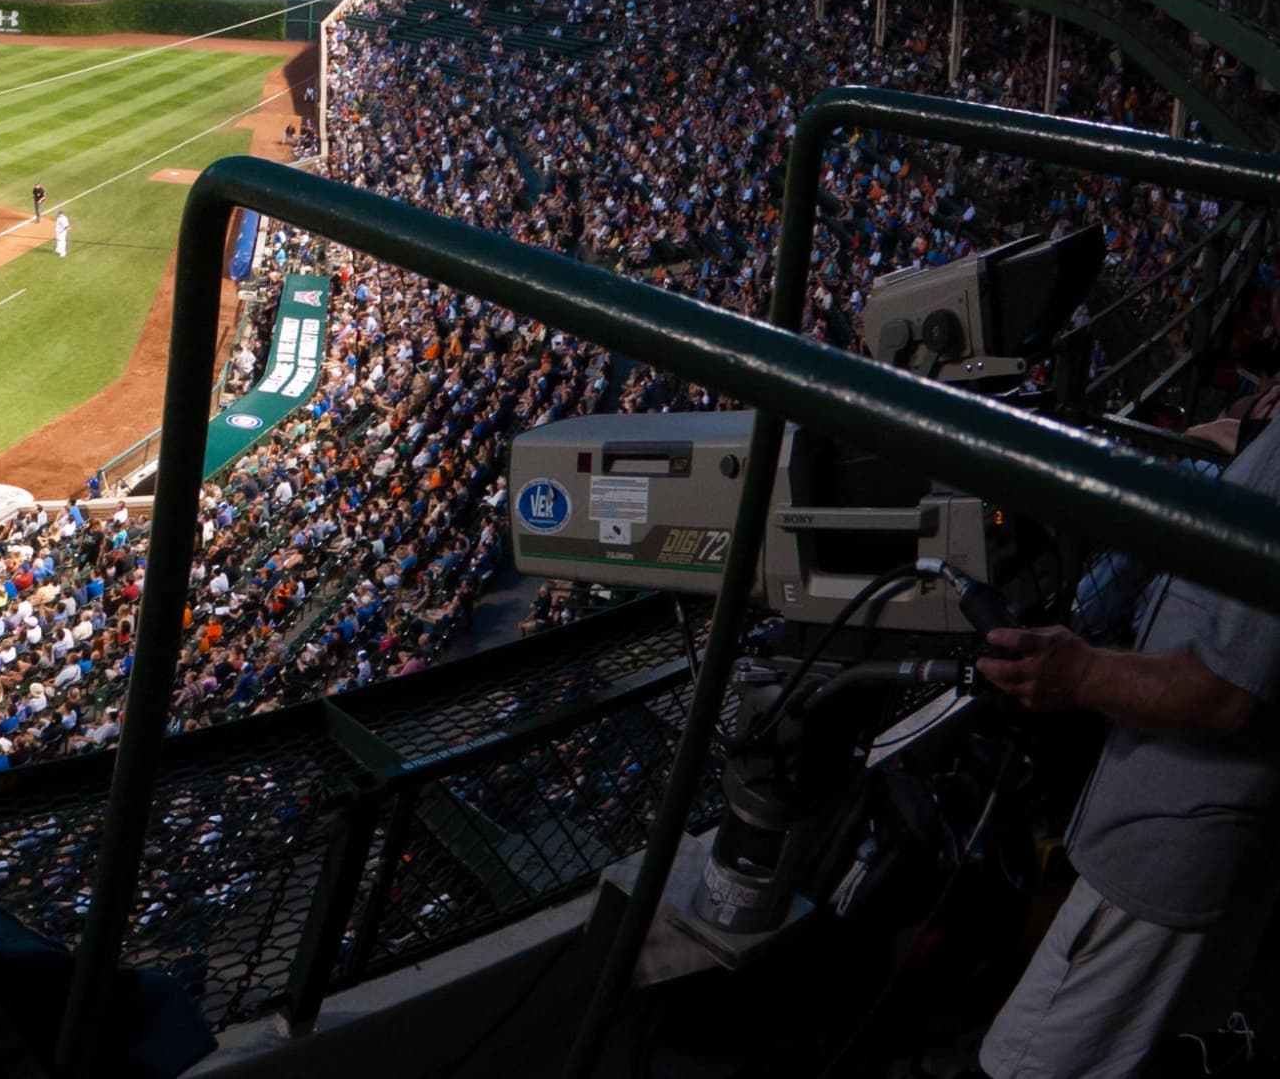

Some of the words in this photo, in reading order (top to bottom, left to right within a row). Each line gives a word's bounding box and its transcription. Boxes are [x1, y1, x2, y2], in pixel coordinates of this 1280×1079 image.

[784, 515, 814, 524] SONY
[661, 528, 704, 553] DIGI
[698, 530, 731, 561] 72
[783, 584, 797, 602] E
